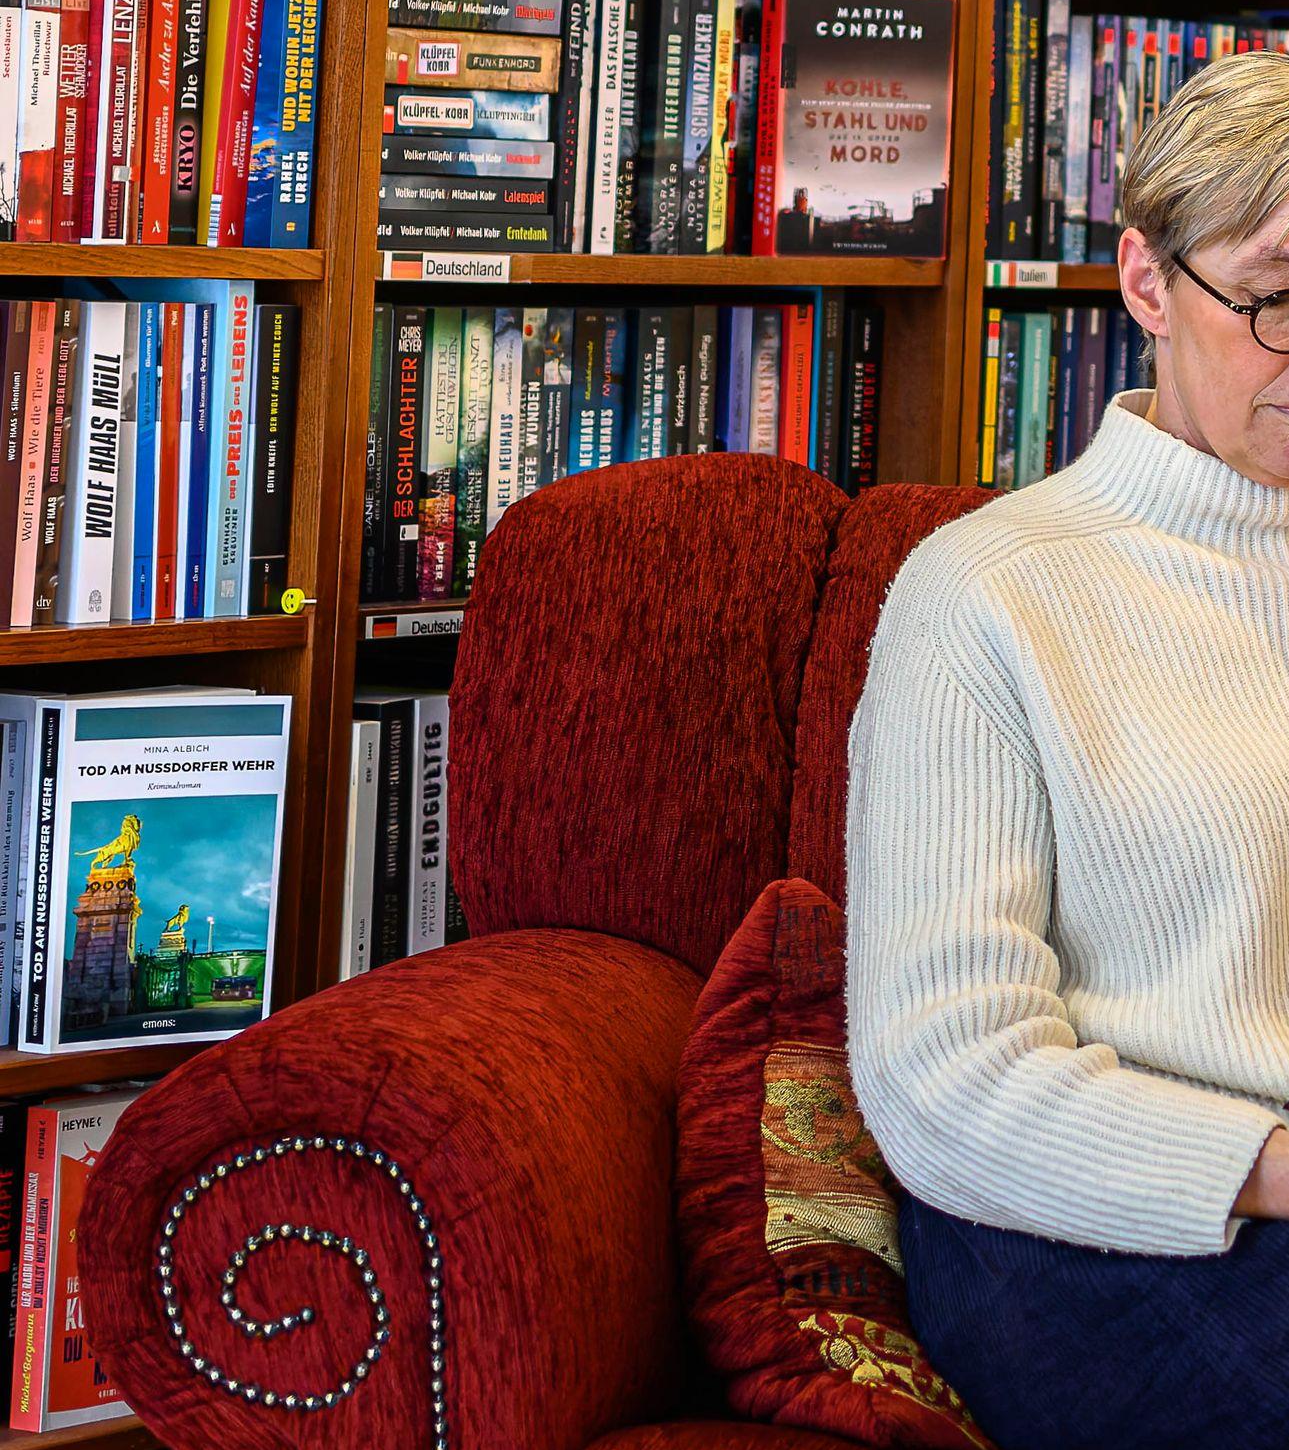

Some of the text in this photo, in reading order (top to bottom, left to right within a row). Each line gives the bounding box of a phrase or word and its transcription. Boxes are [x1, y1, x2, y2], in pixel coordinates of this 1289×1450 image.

[837, 8, 904, 20] MARTIN
[816, 22, 924, 39] CONRATH
[284, 37, 300, 97] WOHIN
[301, 57, 313, 90] DER
[180, 75, 197, 111] Die
[283, 101, 296, 132] UND
[298, 95, 310, 123] MIT
[804, 111, 928, 132] STAHL UND
[177, 123, 195, 197] KRYO
[830, 146, 900, 164] MORD
[280, 152, 294, 203] RAHEL
[295, 150, 308, 205] URECH
[425, 260, 503, 277] Deutschland
[227, 294, 248, 477] PREIS LEBENS
[395, 357, 418, 495] SCHLACHTER
[85, 354, 121, 538] WOLF HAAS MÜLL
[144, 744, 209, 754] MINA ALBICH
[78, 760, 274, 776] TOD AM NUSSDORFER WEHR
[61, 1117, 95, 1131] HEYNE
